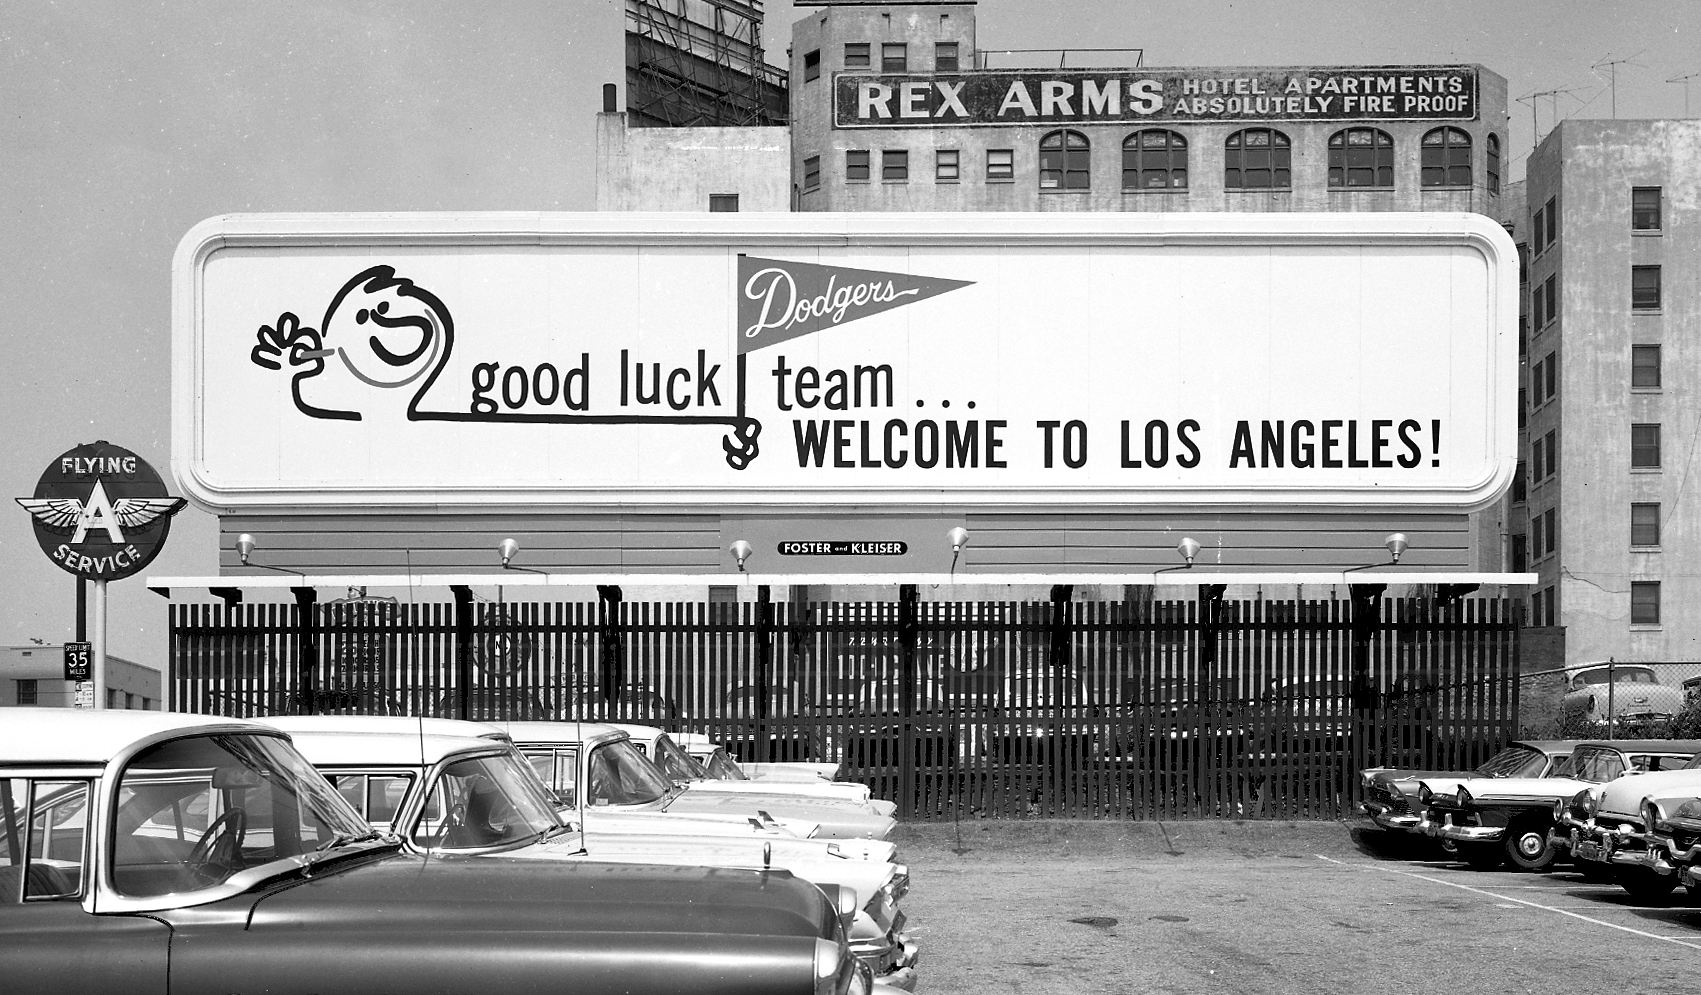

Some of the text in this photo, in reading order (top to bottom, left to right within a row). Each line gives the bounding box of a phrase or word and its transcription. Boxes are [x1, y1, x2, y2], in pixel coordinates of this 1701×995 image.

[858, 79, 1164, 119] REX ARMS
[1184, 76, 1463, 95] HOTEL APARTMENTS
[1173, 95, 1469, 114] ABSOLUTELY FIRE PROOF
[745, 267, 919, 338] Dodgers
[471, 352, 590, 413] good
[621, 349, 722, 411] luck
[772, 355, 893, 411] team
[792, 418, 1441, 469] WELCOME TO LOS ANGELES!
[61, 456, 136, 475] FLYING
[70, 477, 126, 544] A
[53, 543, 141, 575] SERVICE
[784, 543, 831, 553] FOSTER
[851, 543, 902, 554] KLEISER
[68, 651, 88, 667] 35
